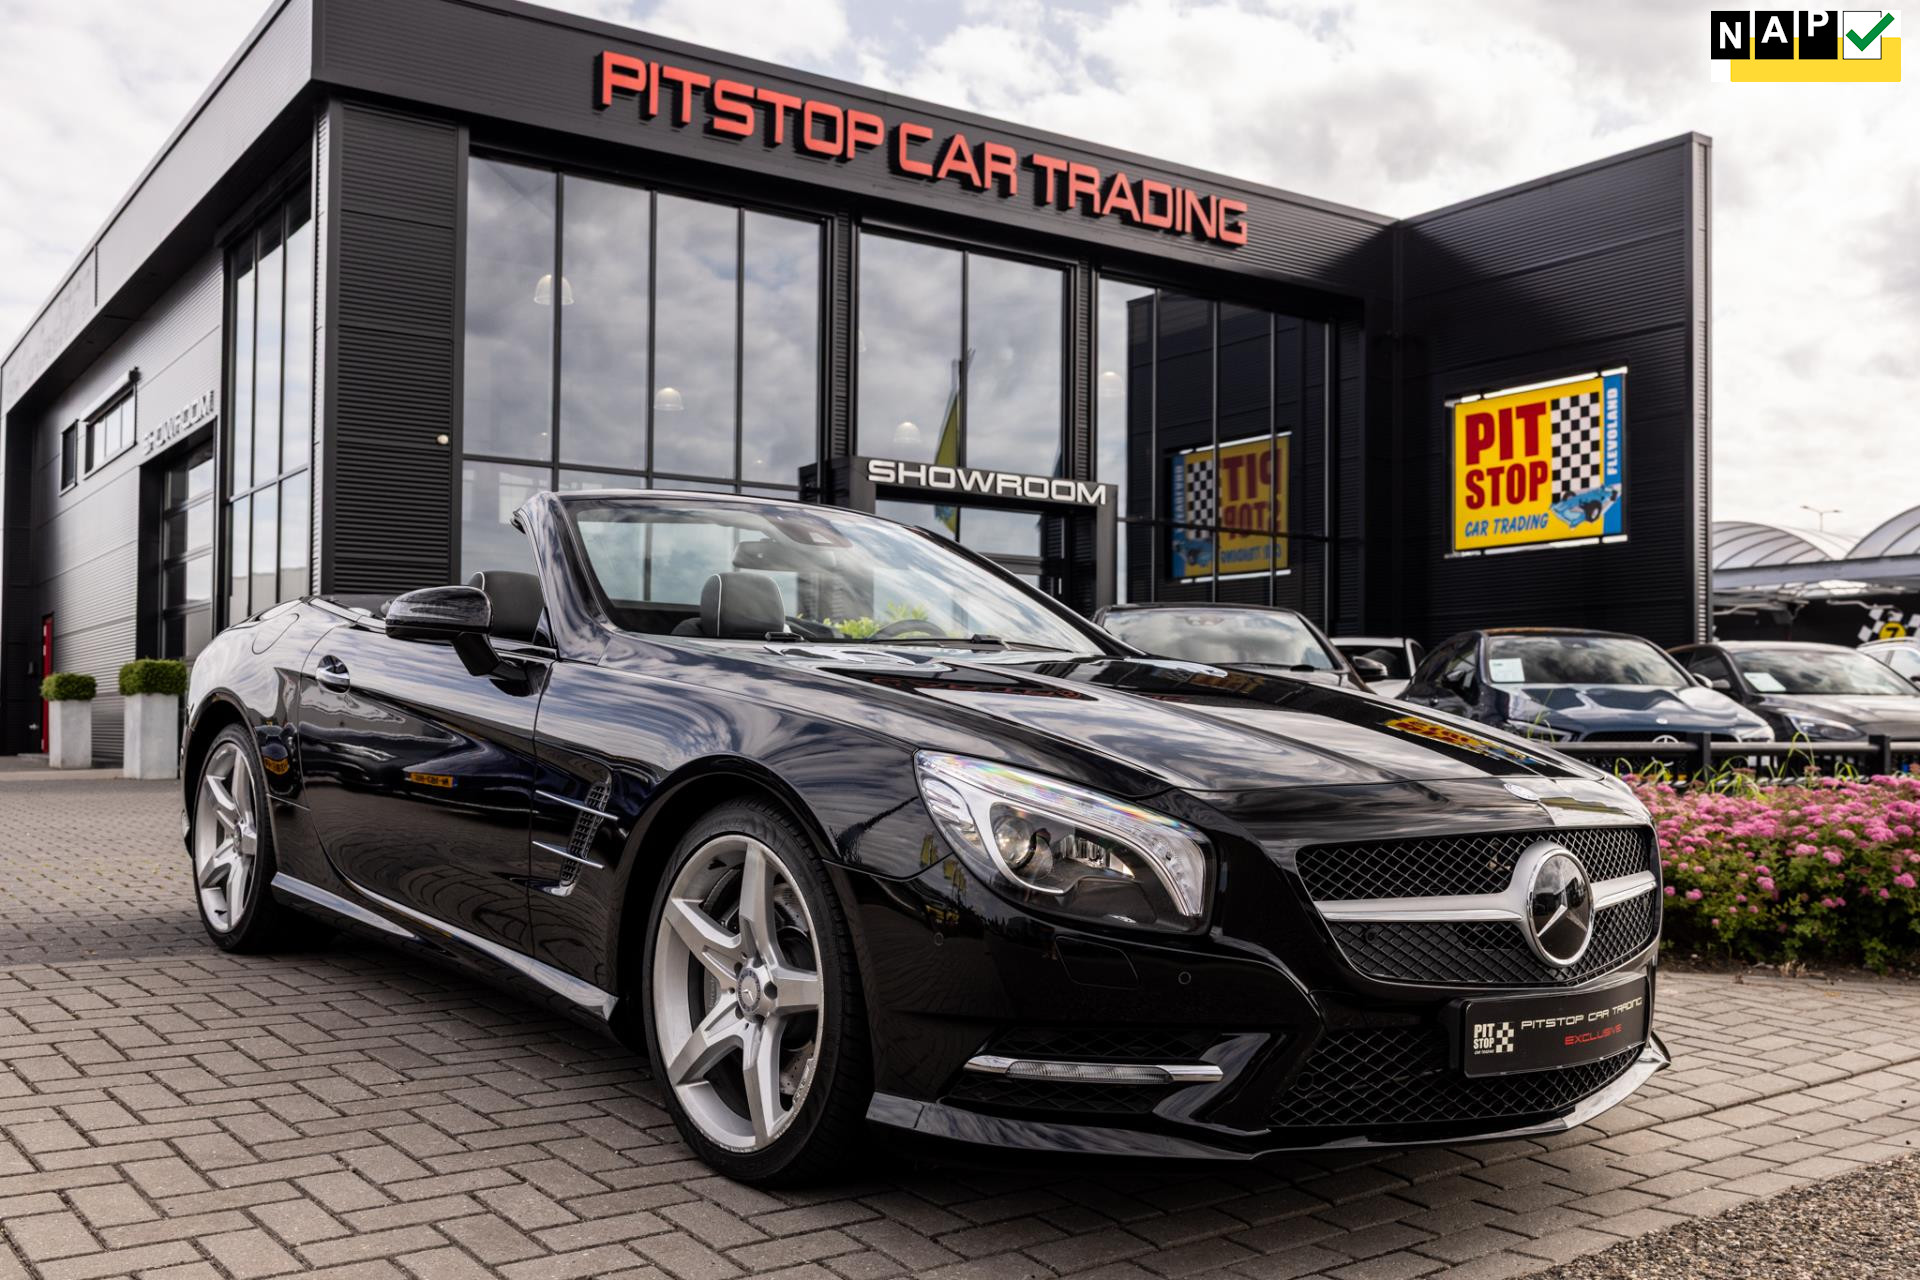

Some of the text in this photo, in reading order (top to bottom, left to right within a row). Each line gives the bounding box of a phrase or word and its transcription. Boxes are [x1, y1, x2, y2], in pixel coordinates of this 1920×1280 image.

[599, 50, 1248, 246] PITSTOP CAR TRADING
[1465, 401, 1547, 466] PIT
[1606, 387, 1619, 475] FLEVOLAND
[868, 459, 1106, 505] SHOWROOM
[1465, 460, 1549, 510] STOP
[1464, 512, 1549, 537] CAR TRADING
[1473, 1023, 1496, 1039] PIT
[1520, 1014, 1585, 1030] PITSTOP
[1587, 1008, 1610, 1022] CAR
[1473, 1037, 1495, 1050] STOP
